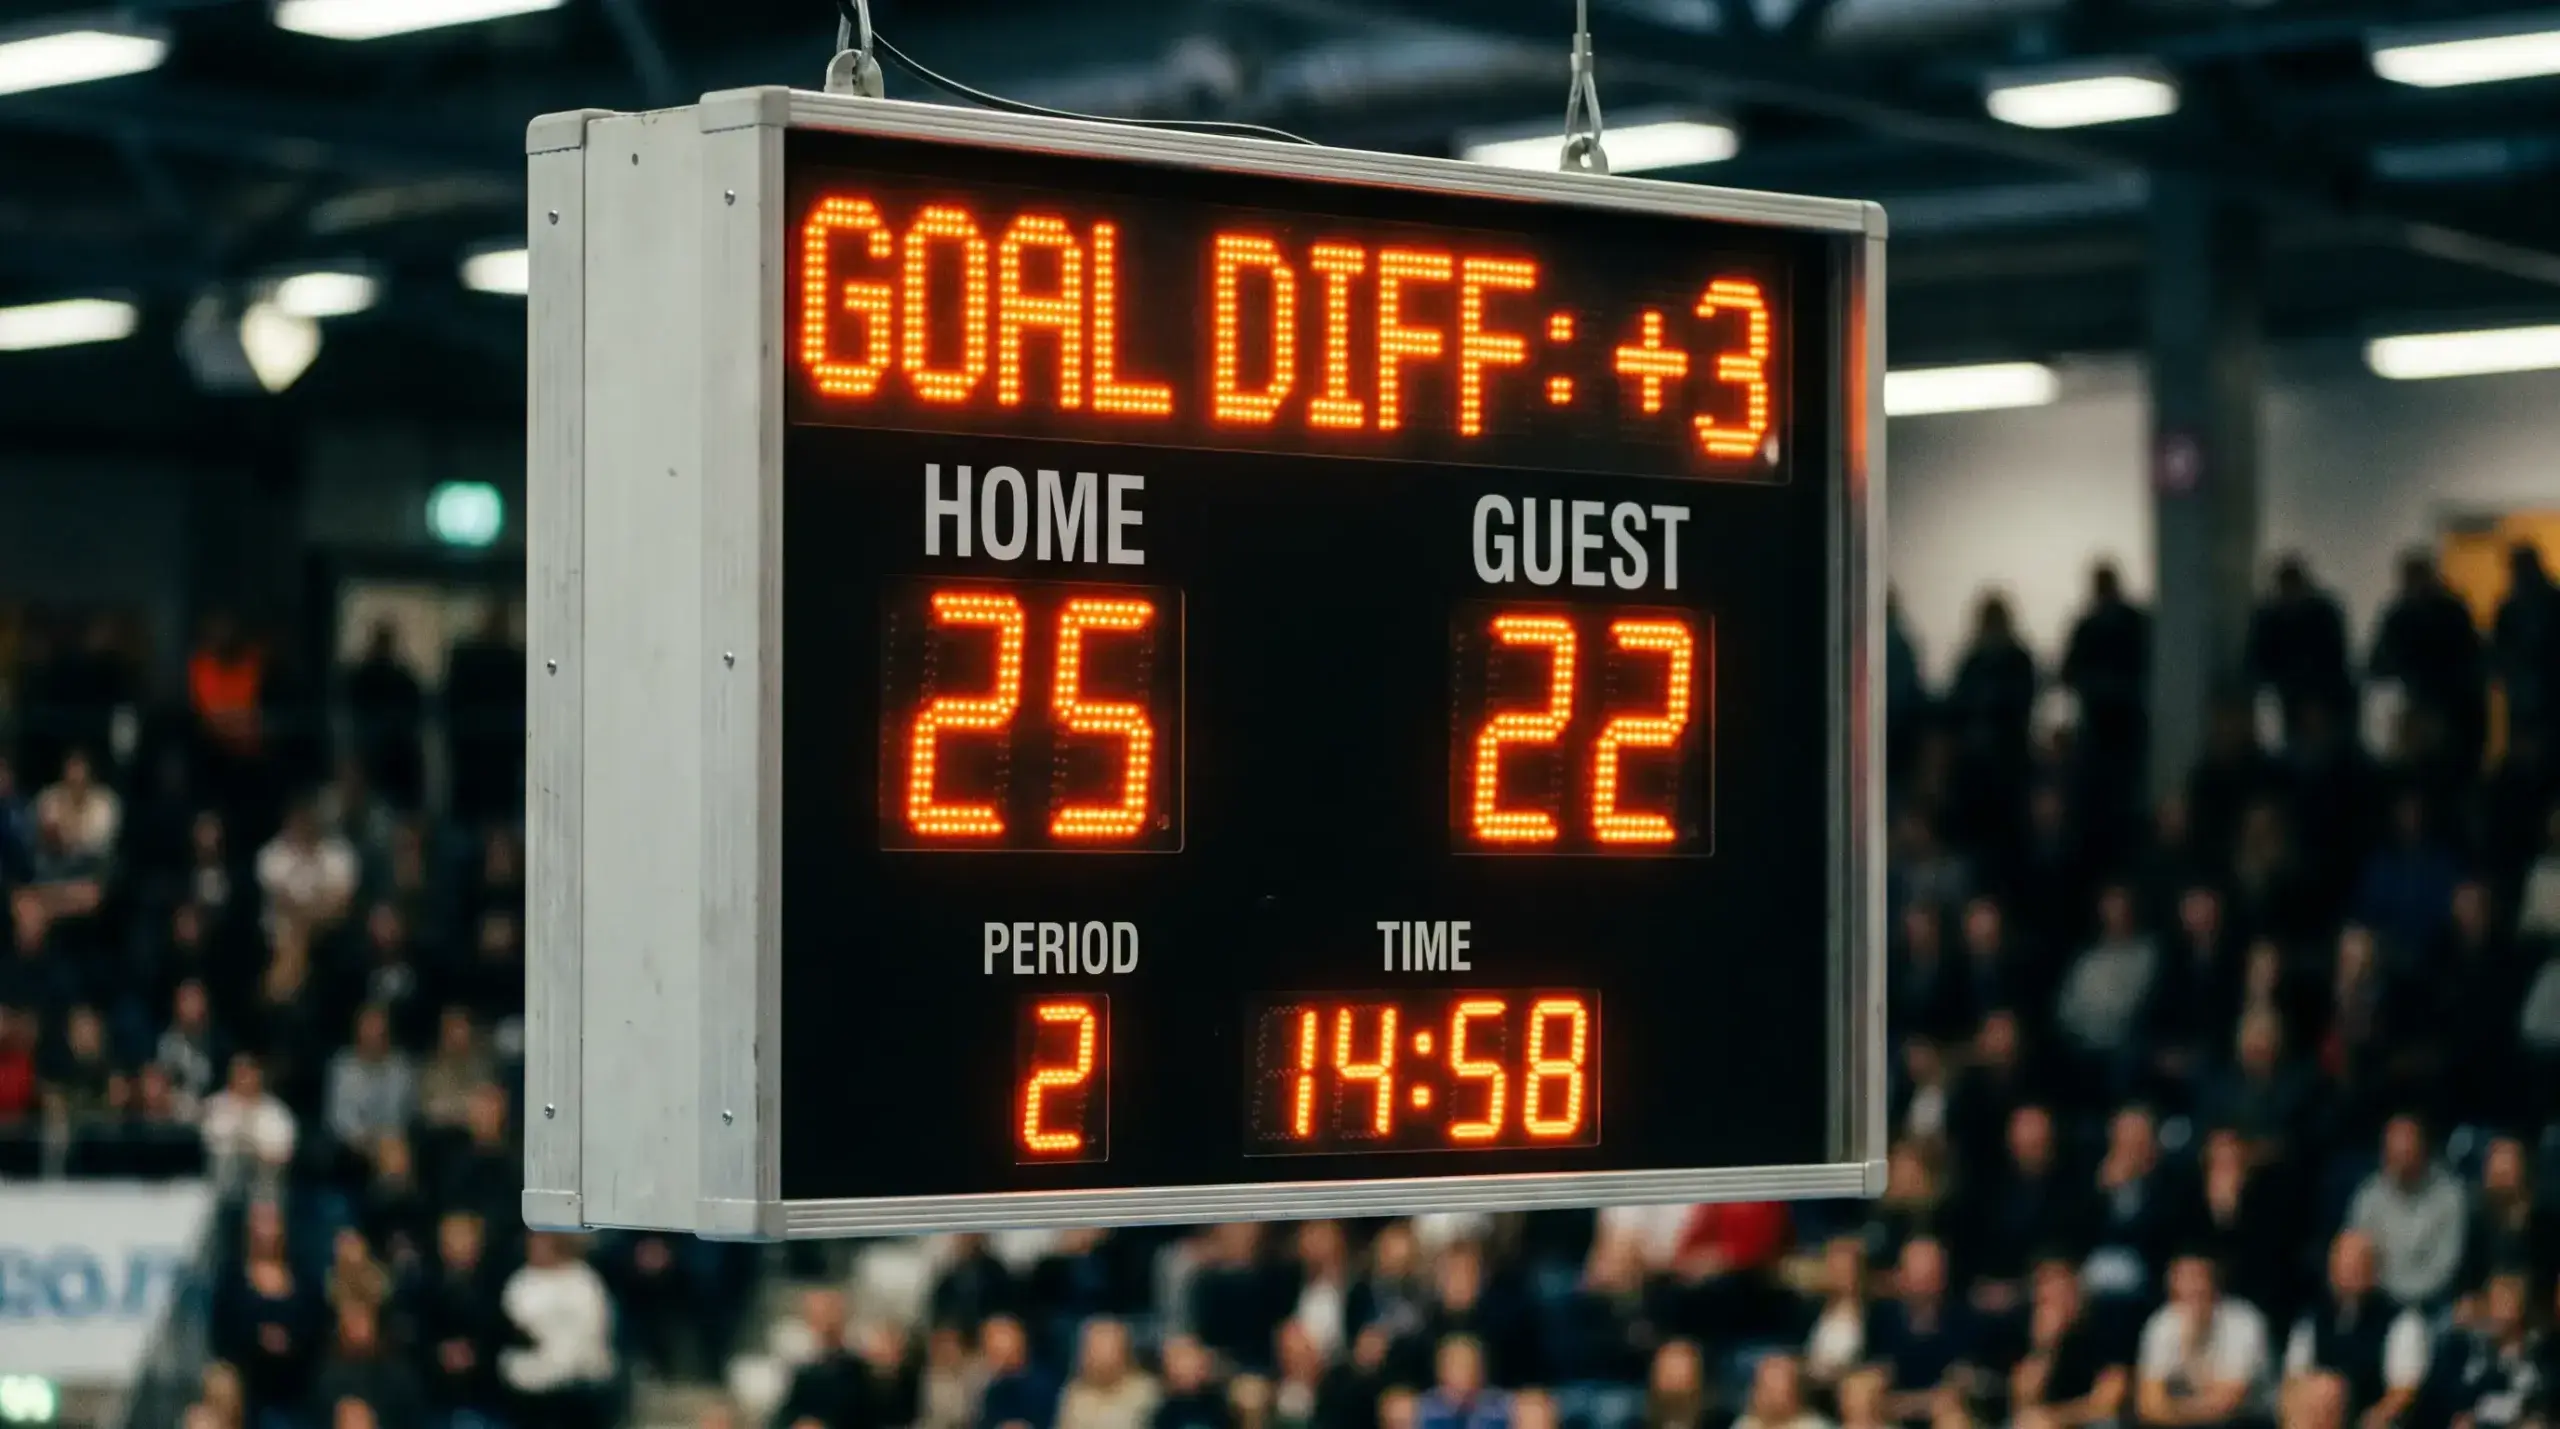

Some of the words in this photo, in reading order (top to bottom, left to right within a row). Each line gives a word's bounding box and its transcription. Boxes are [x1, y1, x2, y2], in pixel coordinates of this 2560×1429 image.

[799, 196, 1173, 416] GOAL
[1211, 232, 1574, 436] DIFF:
[1613, 278, 1771, 458] +3
[925, 463, 1145, 566] HOME
[1473, 494, 1690, 590] GUEST
[905, 591, 1154, 839] 25
[1471, 614, 1693, 844] 22
[983, 920, 1139, 976] PERIOD
[1376, 920, 1472, 972] TIME
[1021, 1001, 1096, 1153] 2
[1291, 996, 1588, 1142] 14:58
